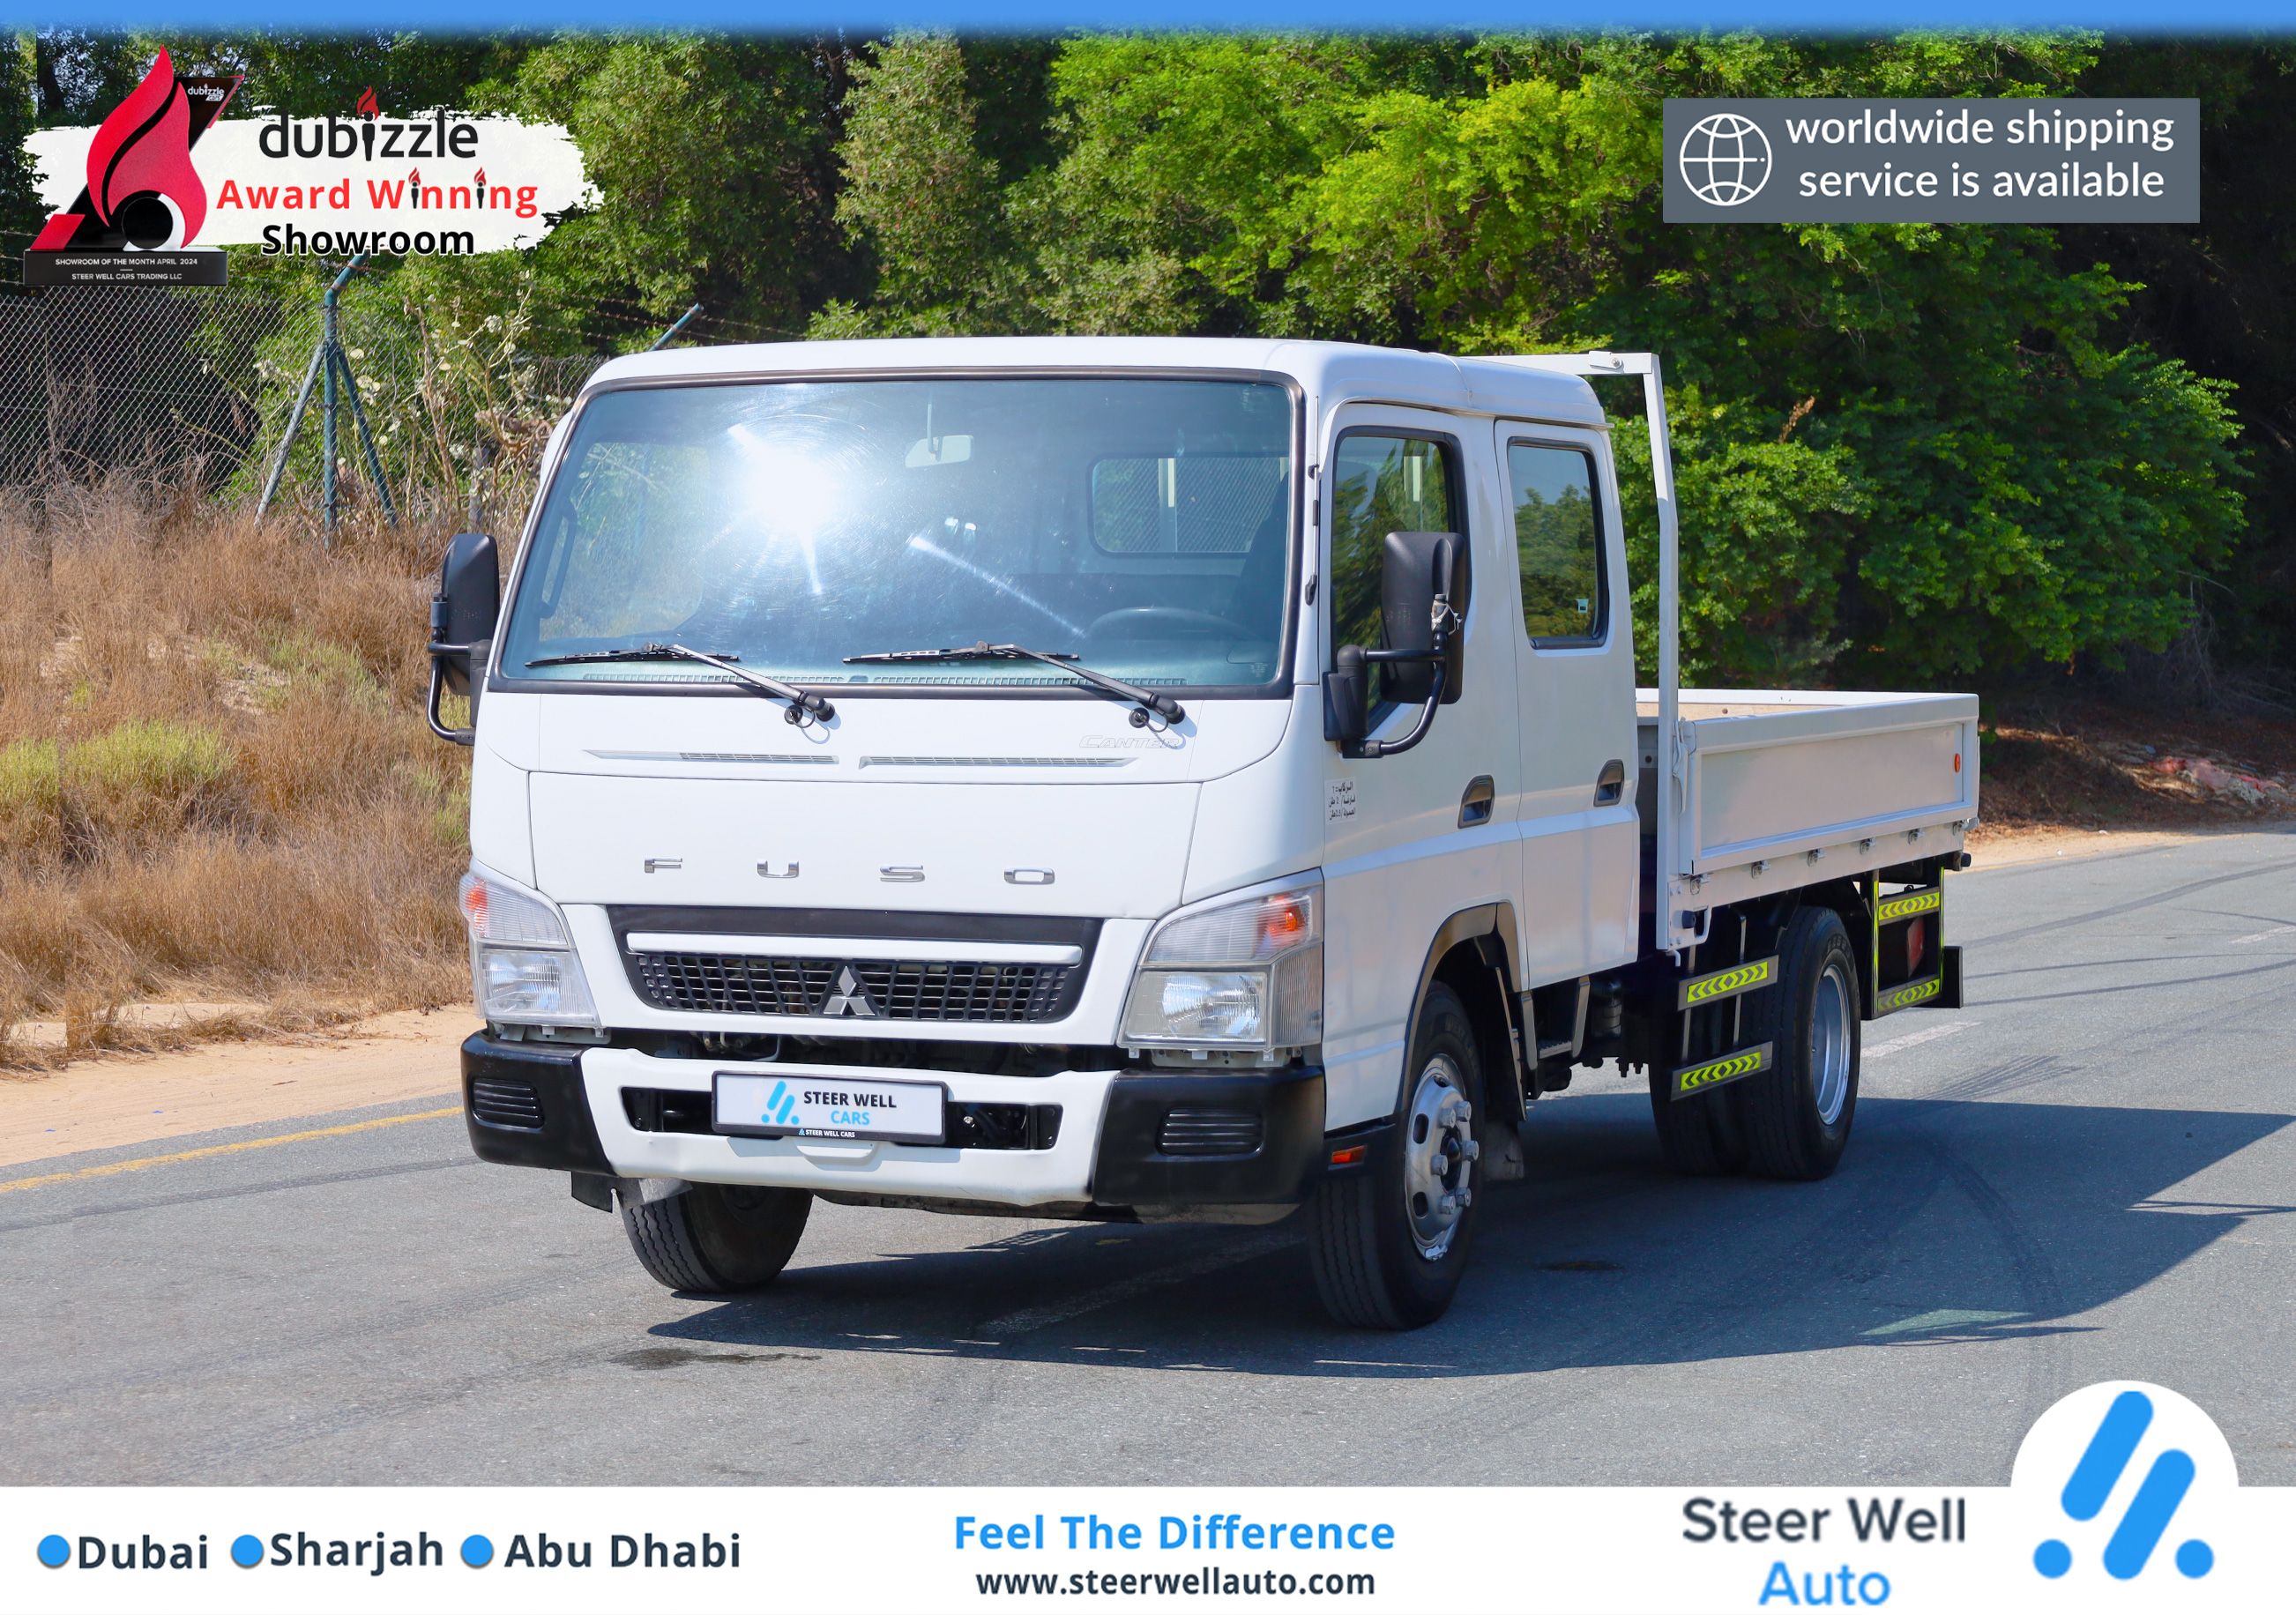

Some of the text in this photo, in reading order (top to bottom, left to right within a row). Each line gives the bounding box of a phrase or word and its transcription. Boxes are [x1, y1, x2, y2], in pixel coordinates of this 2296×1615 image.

[1078, 734, 1180, 749] CANTER
[645, 859, 1055, 885] FUSO
[803, 1090, 897, 1108] STEER WELL
[831, 1109, 870, 1127] CARS
